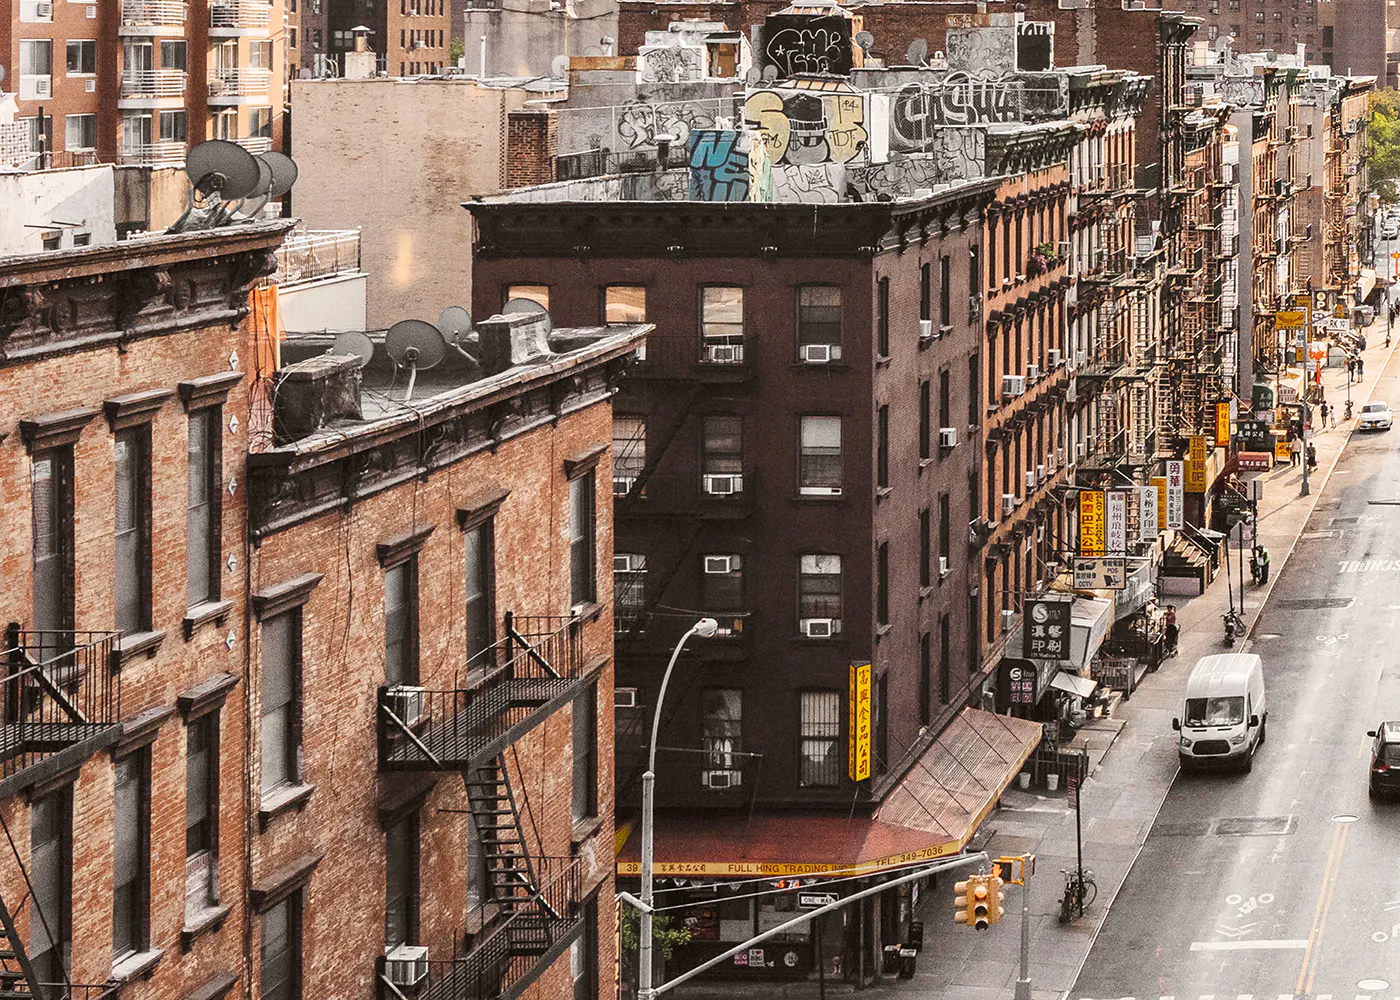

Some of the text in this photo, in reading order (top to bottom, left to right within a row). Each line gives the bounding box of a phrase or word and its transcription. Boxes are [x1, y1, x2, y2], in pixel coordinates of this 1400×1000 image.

[900, 846, 943, 863] 349-7036
[626, 864, 638, 872] 39
[728, 864, 751, 873] FULL
[756, 864, 780, 873] HING
[783, 864, 828, 873] TRADING
